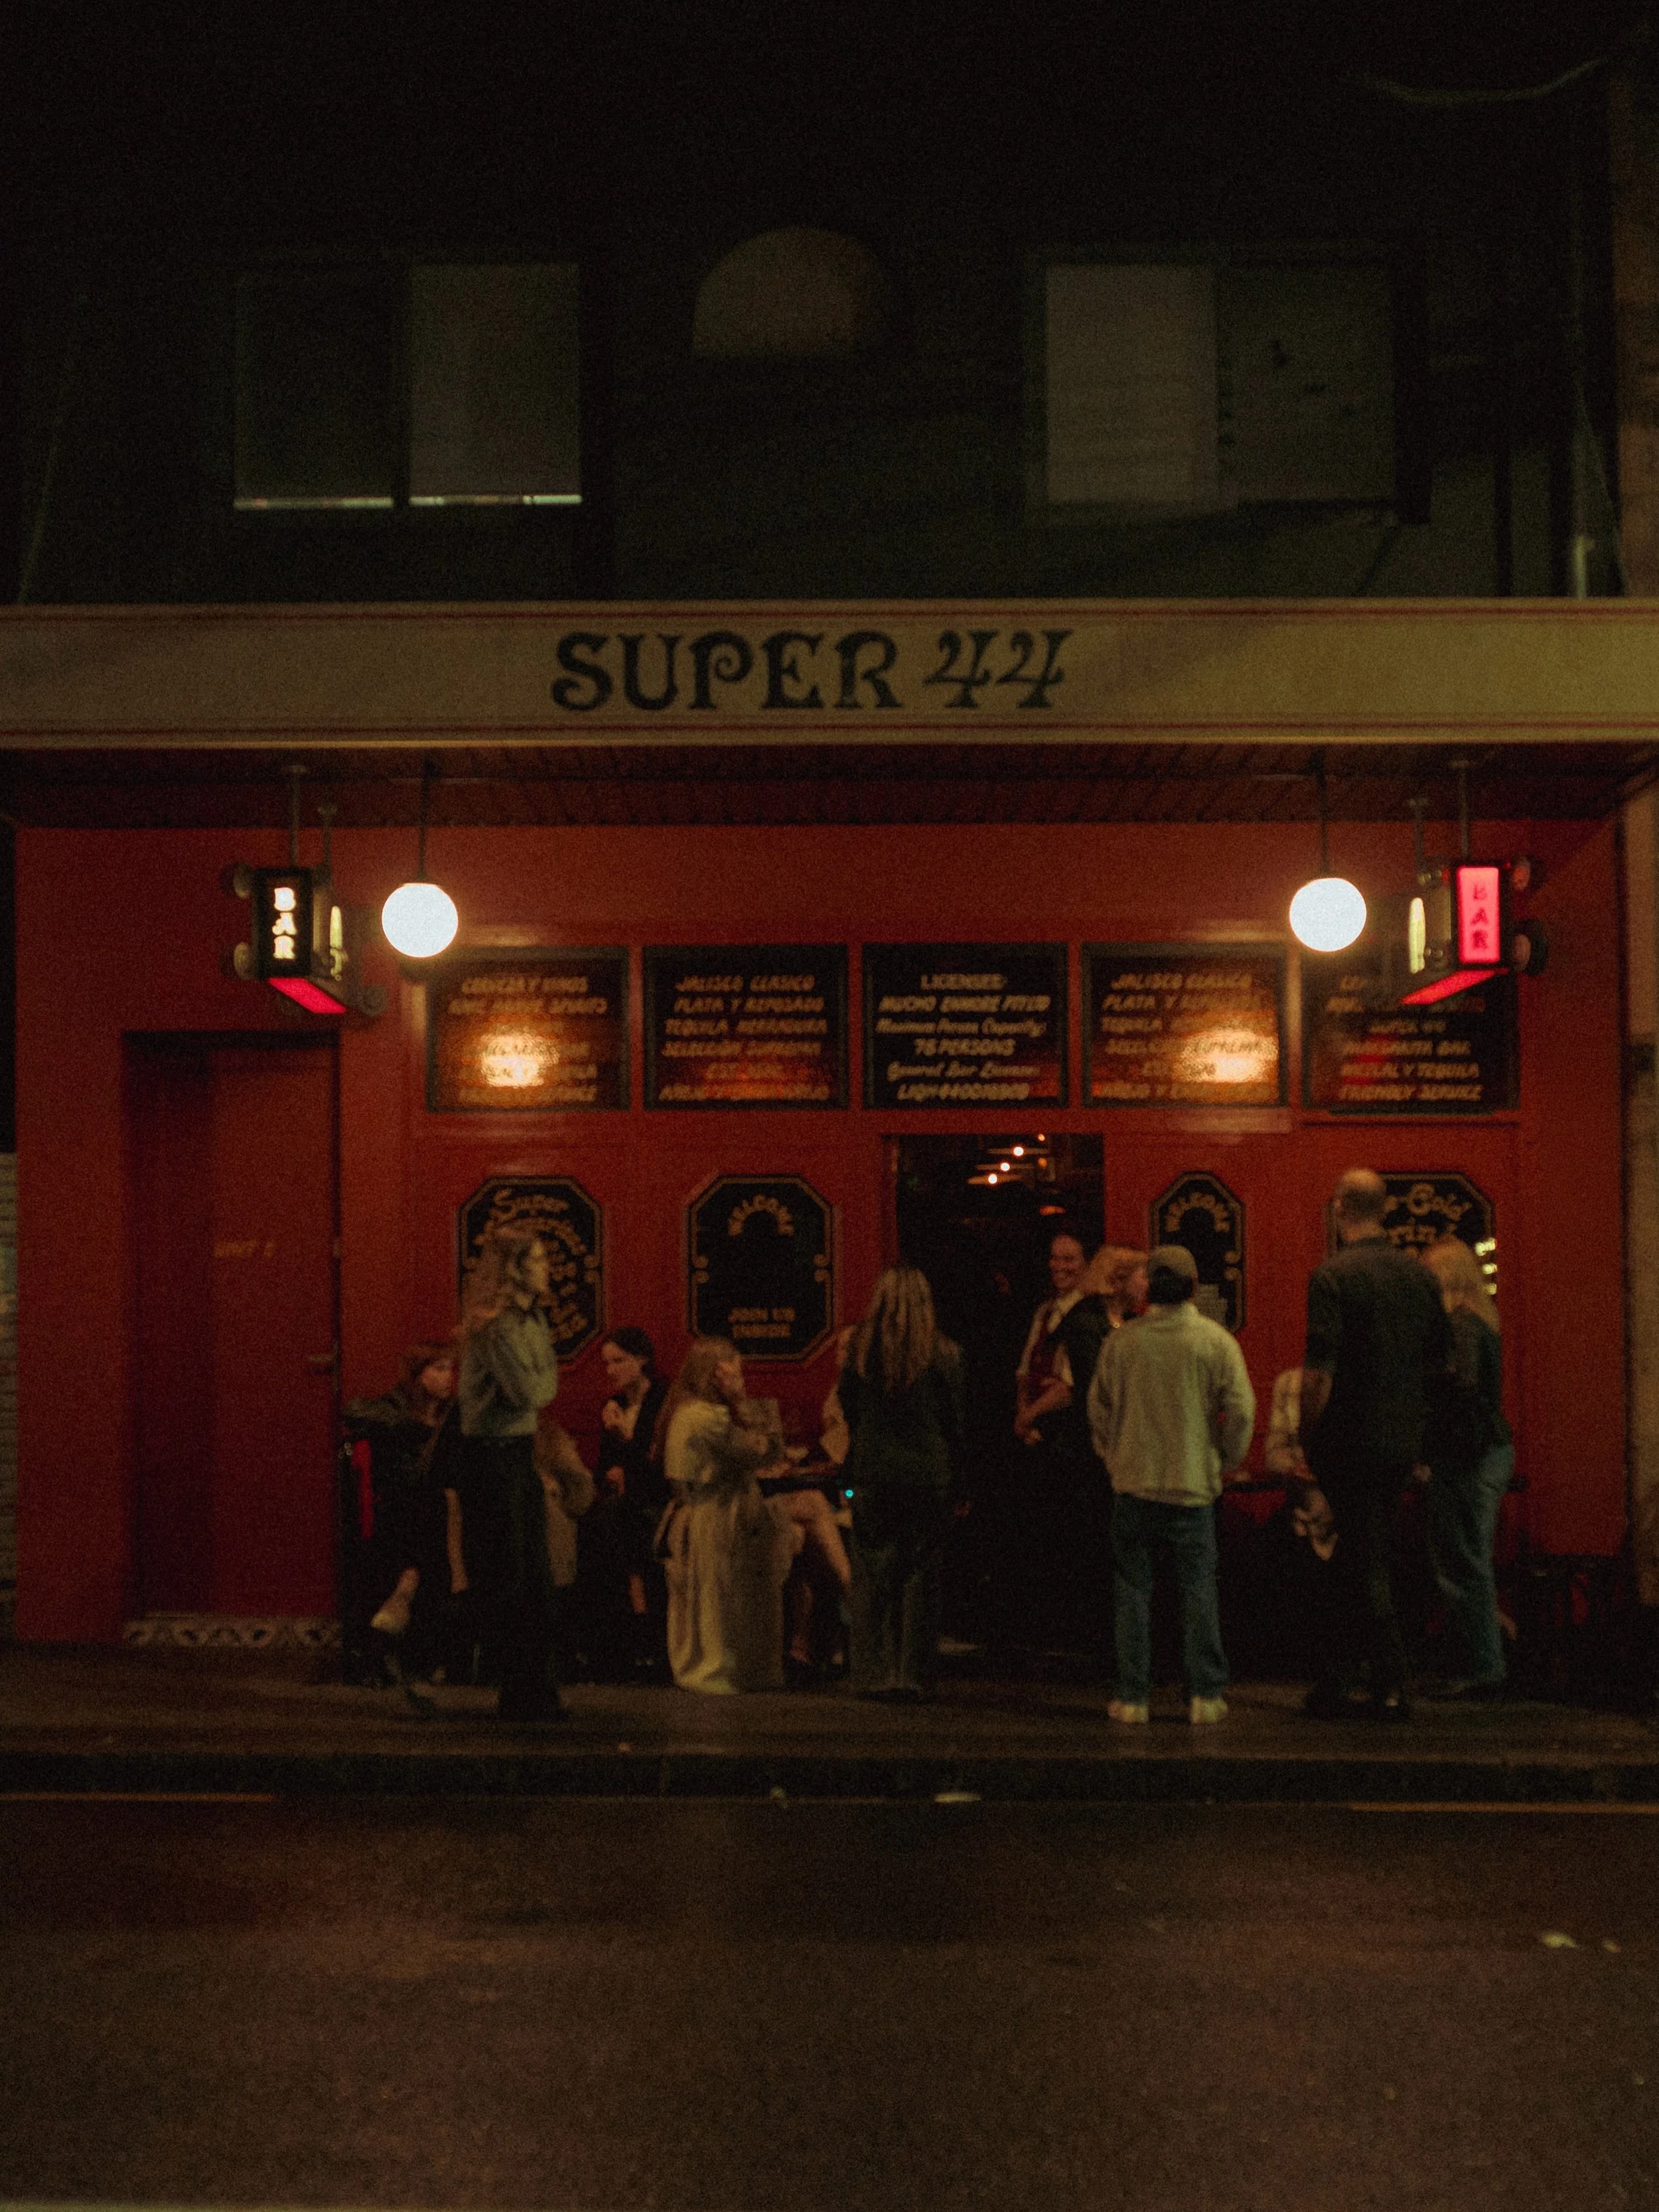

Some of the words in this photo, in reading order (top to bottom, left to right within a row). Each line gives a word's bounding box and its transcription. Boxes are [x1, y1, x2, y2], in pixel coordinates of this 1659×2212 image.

[550, 630, 904, 711] SUPER
[924, 629, 1073, 708] 44
[272, 887, 297, 959] BAR
[676, 975, 744, 992] JALISCO
[674, 997, 724, 1013] PLATA
[744, 996, 825, 1013] REPOSADO
[1101, 994, 1156, 1011] PLATA
[664, 1018, 729, 1036] TEQUILA
[728, 1194, 794, 1236] WELCOME
